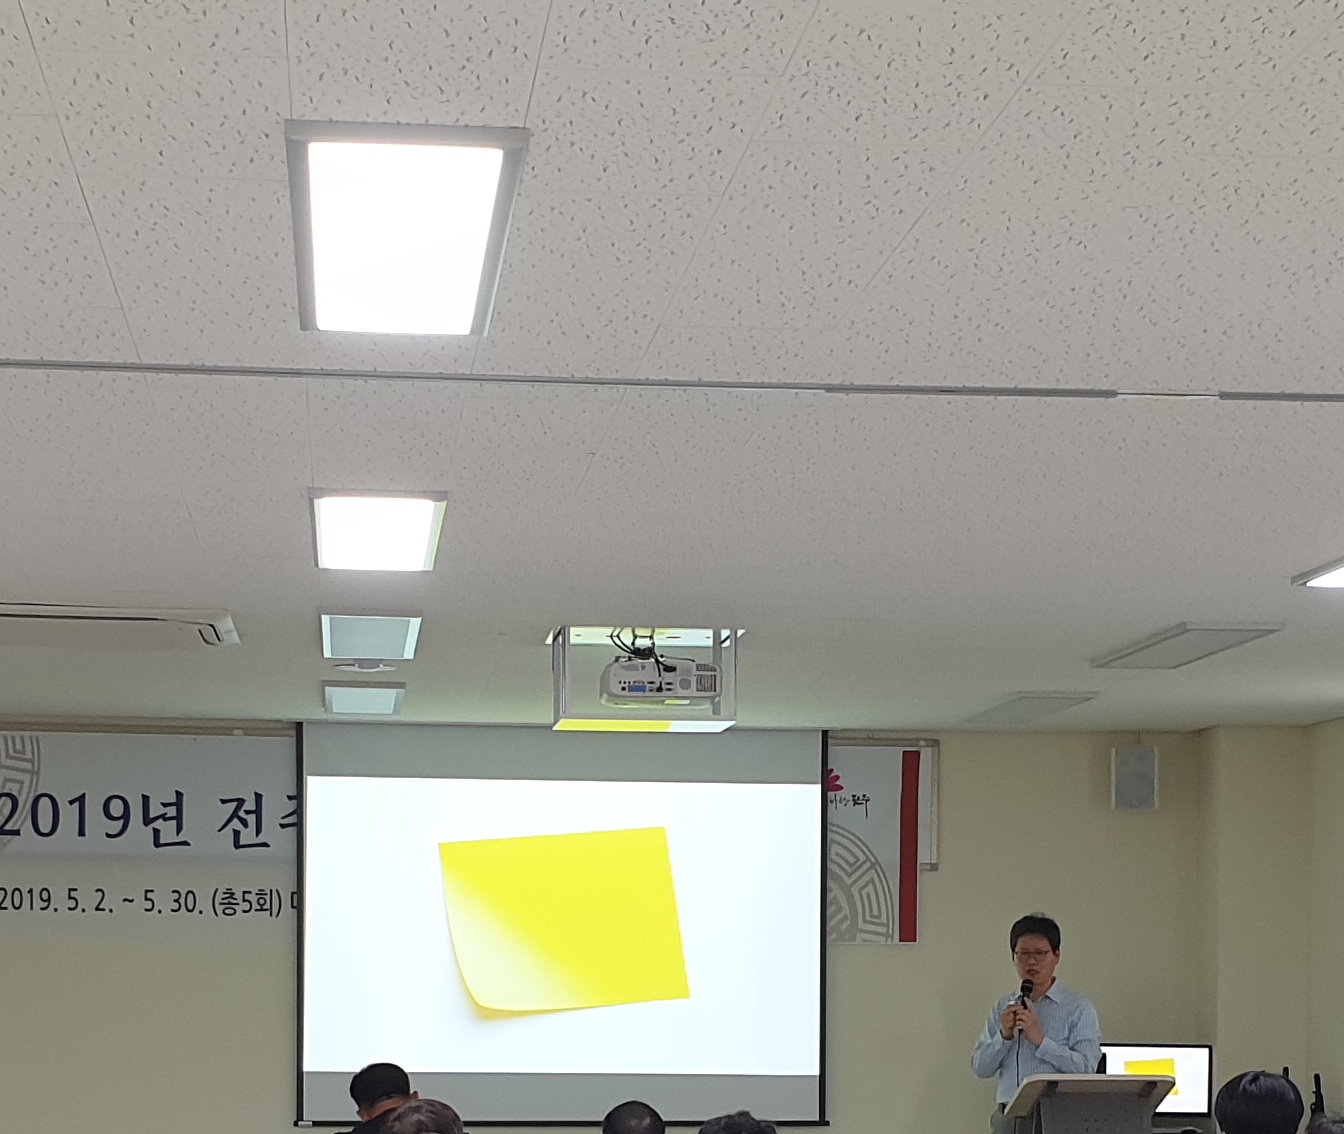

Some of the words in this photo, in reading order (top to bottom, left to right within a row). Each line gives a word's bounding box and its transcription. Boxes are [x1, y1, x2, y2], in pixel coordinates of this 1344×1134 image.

[67, 887, 87, 914] 5.
[94, 888, 114, 914] 2.
[143, 889, 163, 915] 5.
[170, 889, 204, 916] 30.
[211, 887, 283, 918] (총5회)
